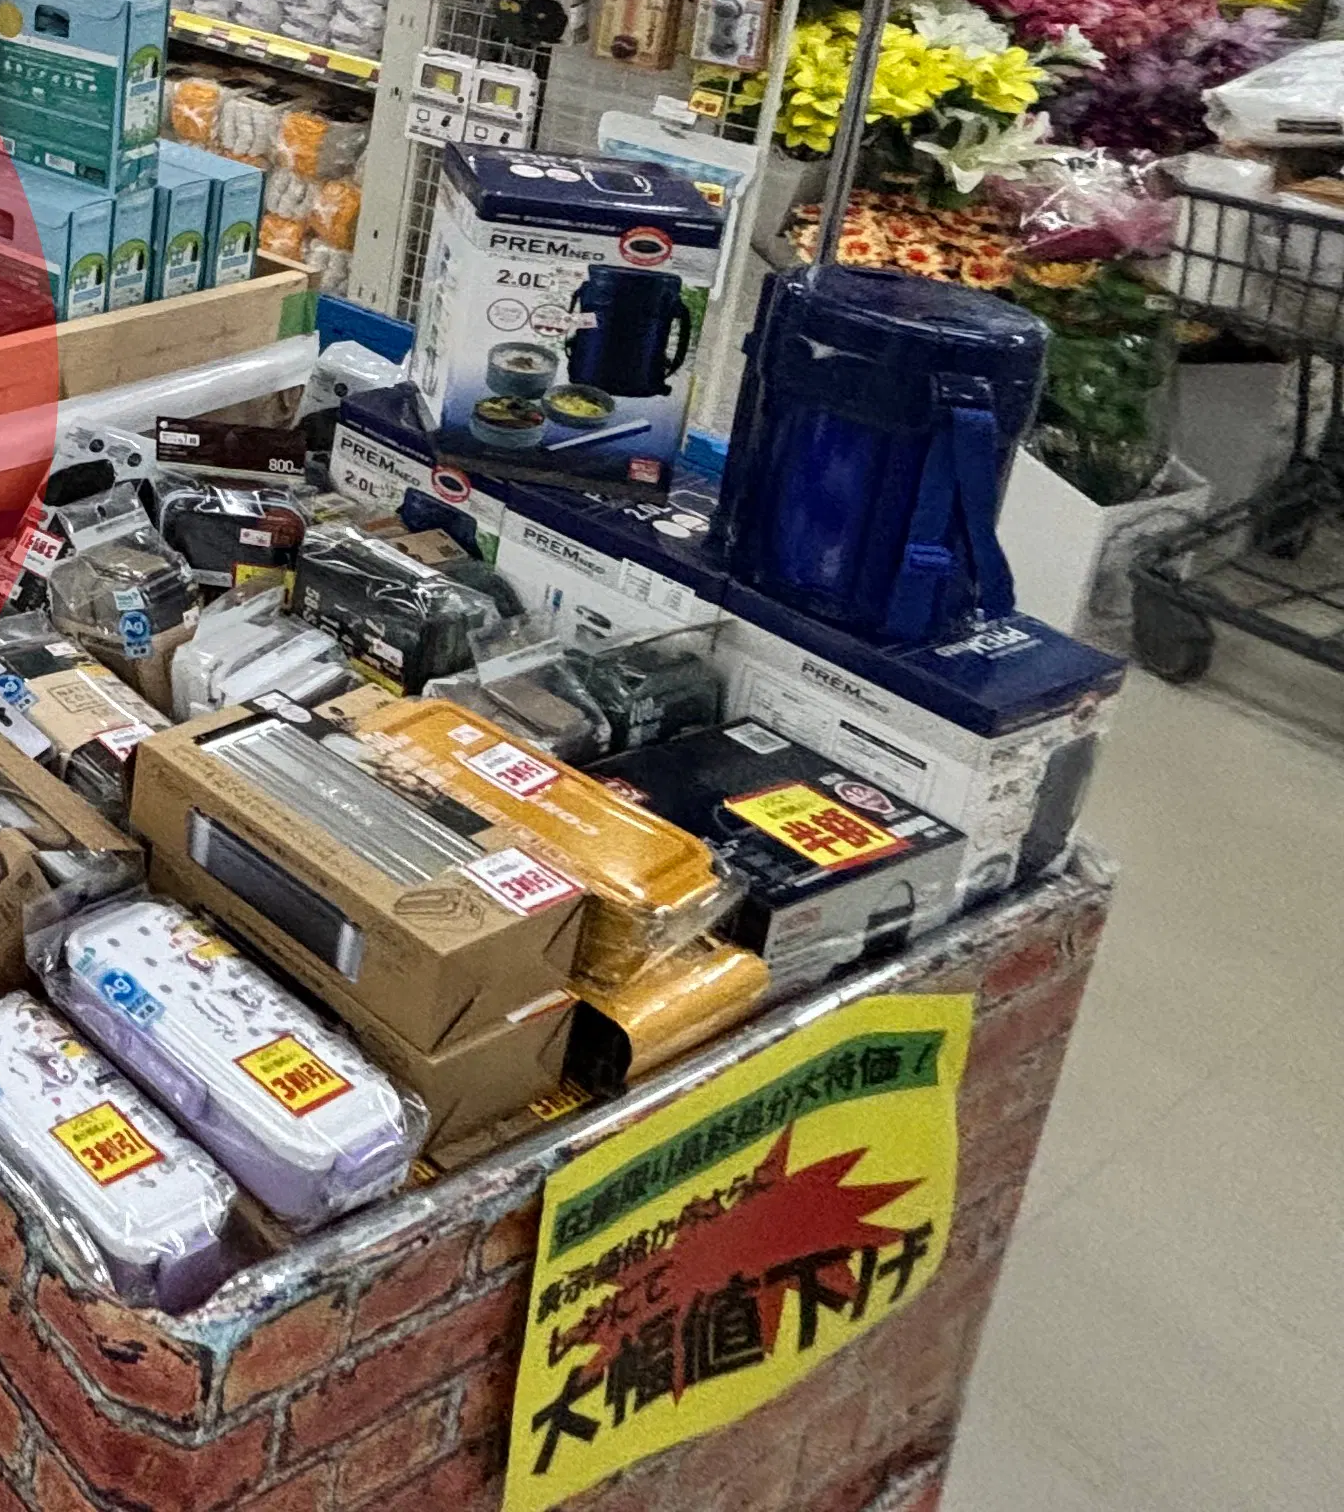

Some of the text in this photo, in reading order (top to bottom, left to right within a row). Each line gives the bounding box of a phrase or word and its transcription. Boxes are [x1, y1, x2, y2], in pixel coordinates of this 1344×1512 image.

[269, 1059, 337, 1102] 3割引
[80, 1127, 145, 1173] 3割引
[530, 1221, 934, 1476] 大幅値下げ
